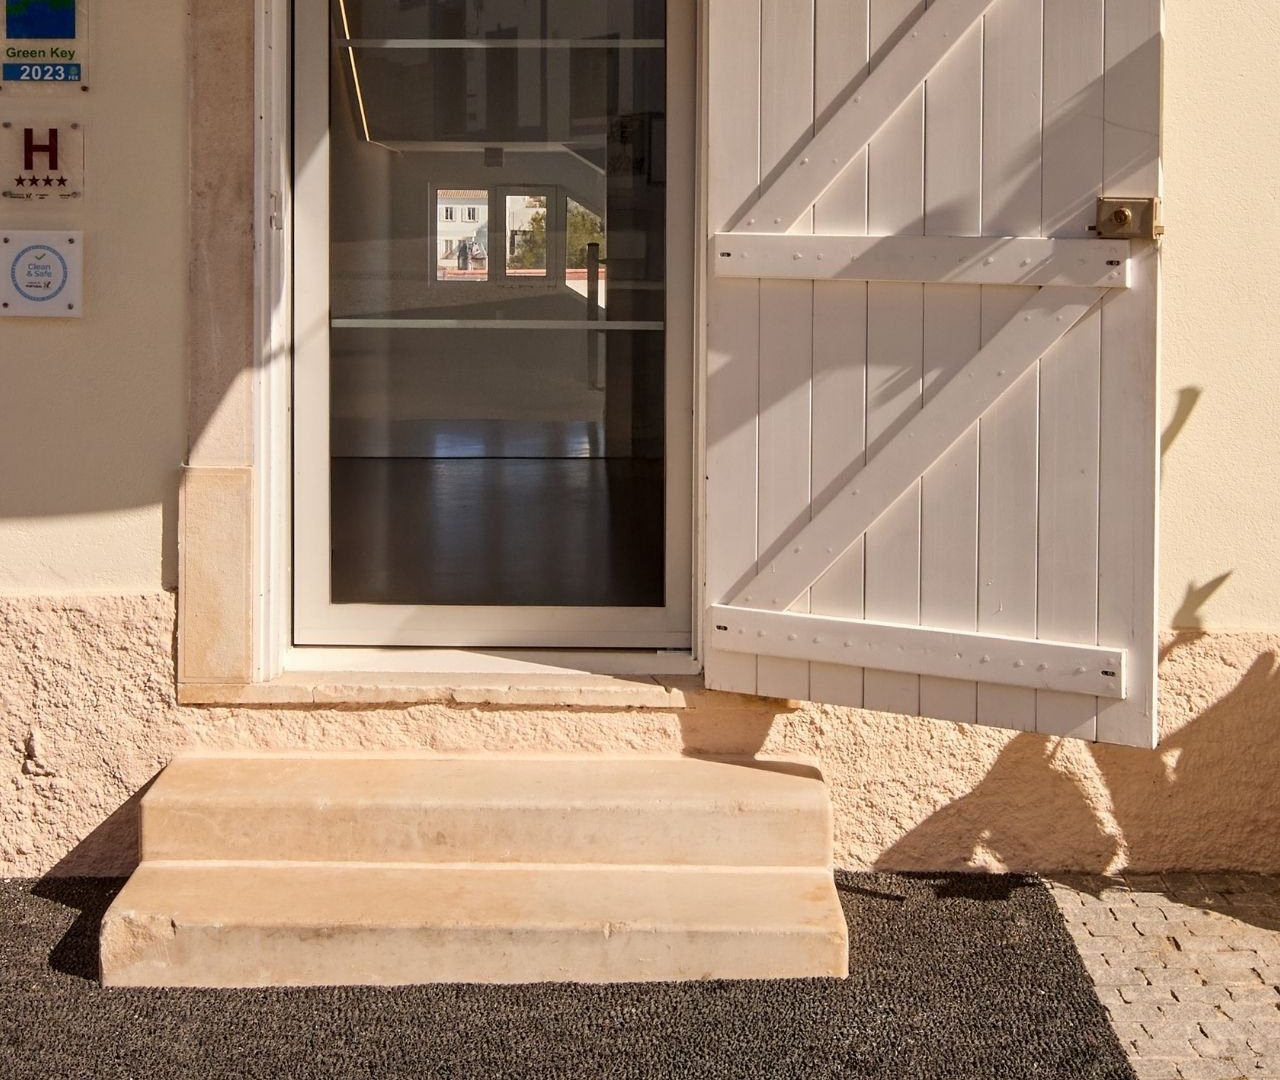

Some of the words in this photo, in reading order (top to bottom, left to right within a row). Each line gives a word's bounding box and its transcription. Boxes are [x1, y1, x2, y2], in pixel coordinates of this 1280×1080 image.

[6, 47, 46, 58] Green
[50, 47, 76, 61] Key
[20, 65, 65, 80] 2023
[24, 128, 58, 170] H
[34, 270, 52, 278] Safe
